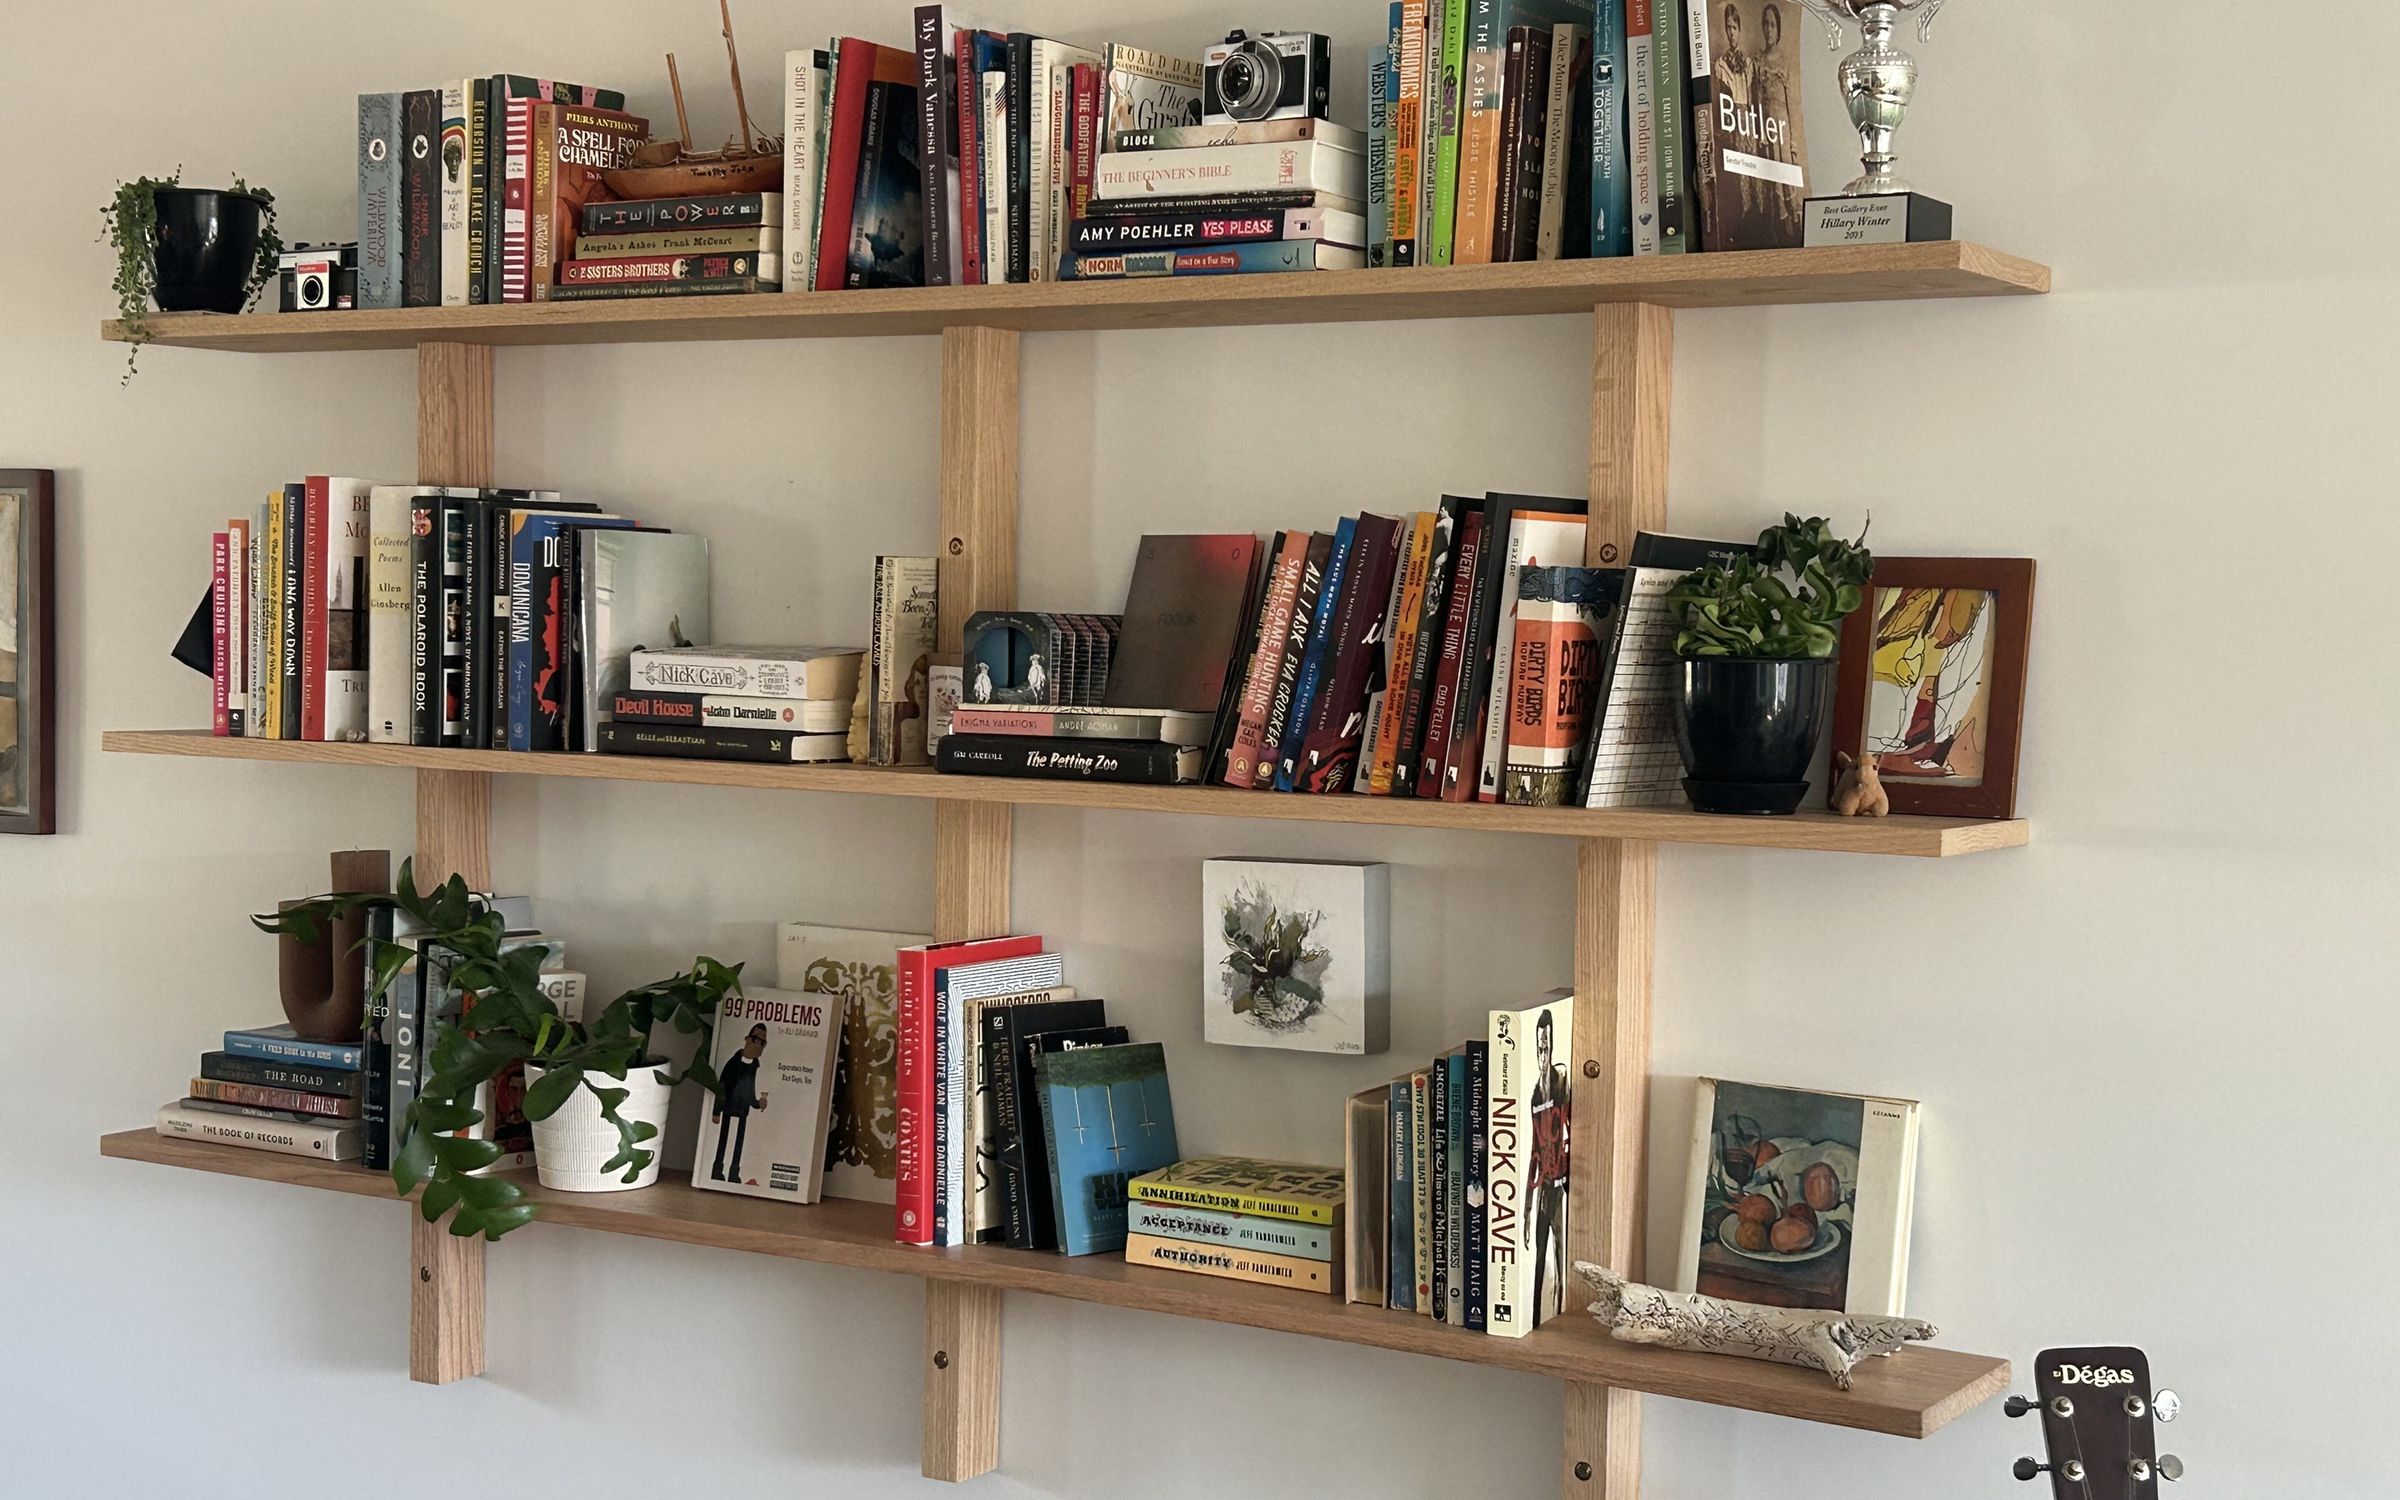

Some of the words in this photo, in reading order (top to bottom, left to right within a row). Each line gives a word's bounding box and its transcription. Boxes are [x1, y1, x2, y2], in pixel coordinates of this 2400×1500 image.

[919, 18, 935, 43] My
[1476, 23, 1488, 54] THE
[1693, 10, 1702, 40] Judith
[1116, 45, 1166, 68] ROALD
[1399, 2, 1423, 100] FREAKONOMICS
[1556, 33, 1568, 61] Alice
[1637, 44, 1649, 67] the
[1695, 42, 1704, 70] Butler
[794, 66, 806, 92] SHOT
[922, 47, 937, 88] Dark
[1637, 69, 1649, 89] art
[1660, 41, 1670, 86] ELEVEN
[794, 97, 805, 108] IN
[1078, 91, 1091, 113] THE
[1158, 85, 1186, 111] The
[1371, 61, 1387, 128] WEBSTER'S
[1472, 63, 1485, 118] ASHES
[1638, 92, 1650, 108] of
[566, 113, 595, 126] PIERS
[596, 117, 640, 133] ANTHONY
[794, 112, 806, 132] THE
[925, 91, 939, 155] Vanessa
[1441, 84, 1457, 137] SKIN
[1552, 105, 1563, 127] The
[1604, 88, 1612, 131] WALKING
[1662, 97, 1671, 124] EMILY
[1718, 93, 1787, 146] Butler
[558, 127, 569, 145] A
[571, 129, 615, 152] SPELL
[1122, 134, 1155, 147] BLOCK
[1593, 89, 1605, 163] TOGETHER
[1635, 110, 1651, 164] holding
[1697, 109, 1709, 144] Gender
[793, 137, 805, 170] HEART
[1077, 115, 1090, 177] GODFATHER
[1549, 128, 1560, 166] Moons
[1103, 172, 1125, 183] THE
[1128, 168, 1196, 182] BEGINNER'S
[1199, 165, 1232, 178] BIBLE
[1370, 136, 1386, 204] THESAURUS
[1549, 167, 1558, 179] of
[1635, 166, 1650, 204] space
[1665, 172, 1675, 209] MANDEL
[411, 173, 421, 260] WILDWOOD
[421, 193, 430, 236] UNDER
[660, 203, 735, 222] POWER
[1820, 217, 1855, 231] Hillary
[1857, 216, 1891, 227] Winter
[1823, 206, 1839, 214] Best
[1840, 204, 1868, 215] Gallery
[1869, 203, 1888, 213] Ever
[367, 192, 377, 265] IMPERIUM
[377, 186, 387, 268] WILDWOOD
[1080, 227, 1114, 242] AMY
[1120, 224, 1195, 240] POEHLER
[1202, 220, 1225, 236] YES
[1230, 218, 1274, 234] PLEASE
[470, 230, 483, 274] CROUCH
[583, 243, 624, 253] Angela's
[664, 239, 690, 248] Frank
[693, 238, 733, 247] McCourt
[586, 264, 624, 279] SISTERS
[624, 262, 670, 277] BROTHERS
[1087, 256, 1123, 273] NORM
[215, 543, 226, 572] PARK
[373, 535, 410, 548] Collected
[1508, 537, 1518, 577] maxine
[377, 553, 403, 564] Poems
[1457, 544, 1474, 578] EVERY
[377, 583, 402, 593] Allen
[416, 561, 427, 589] THE
[1279, 558, 1300, 603] SMALL
[1303, 560, 1321, 594] ALL
[215, 577, 226, 634] CRUISING
[370, 599, 411, 611] Ginsberg
[511, 562, 531, 643] DOMINICANA
[1300, 597, 1312, 610] I
[1449, 584, 1469, 627] LITTLE
[416, 594, 427, 667] POLAROID
[1269, 608, 1289, 649] GAME
[1290, 607, 1311, 649] ASK
[286, 638, 297, 676] DOWN
[1443, 629, 1462, 660] THING
[659, 666, 696, 685] Nick
[699, 668, 734, 686] Cave
[1282, 652, 1298, 681] EVA
[1526, 641, 1545, 685] DIRTY
[415, 671, 426, 712] BOOK
[1252, 652, 1278, 715] HUNTING
[615, 697, 649, 716] Devil
[652, 699, 694, 718] House
[733, 706, 777, 720] Darnielle
[1265, 682, 1291, 748] CROCKER
[1524, 687, 1544, 727] BIRDS
[665, 734, 706, 745] SEBASTIAN
[991, 719, 1038, 730] VARIATIONS
[1026, 750, 1048, 768] The
[1049, 751, 1092, 775] Petting
[1095, 754, 1118, 771] Zoo
[904, 970, 913, 1020] EIGHT
[936, 991, 946, 1023] WOLF
[724, 996, 744, 1018] 99
[746, 1000, 823, 1028] PROBLEMS
[936, 1025, 946, 1038] IN
[397, 1009, 413, 1087] JONI
[903, 1027, 913, 1077] YEARS
[936, 1041, 946, 1079] WHITE
[1000, 1035, 1010, 1066] TERRY
[1472, 1050, 1482, 1072] The
[264, 1070, 287, 1082] THE
[292, 1073, 323, 1086] ROAD
[936, 1082, 946, 1105] VAN
[995, 1082, 1006, 1126] GAIMAN
[1003, 1071, 1015, 1131] PRATCHETT
[1470, 1076, 1483, 1128] Midnight
[202, 1125, 217, 1135] THE
[219, 1127, 241, 1139] BOOK
[244, 1130, 255, 1140] OF
[257, 1132, 294, 1146] RECORDS
[936, 1112, 946, 1142] JOHN
[1435, 1128, 1446, 1149] Life
[1492, 1097, 1517, 1173] NICK
[900, 1107, 913, 1181] COATES
[1470, 1133, 1483, 1177] Library
[936, 1144, 946, 1206] DARNIELLE
[1008, 1172, 1017, 1202] GOOD
[1434, 1170, 1447, 1202] Times
[1450, 1171, 1461, 1206] BRAVING
[1140, 1186, 1240, 1209] ANNIHILATION
[1242, 1199, 1257, 1210] JEFF
[1258, 1201, 1300, 1216] VANDERMEER
[1435, 1203, 1447, 1216] of
[1142, 1214, 1232, 1238] ACCEPTANCE
[1239, 1229, 1253, 1239] JEFF
[1255, 1231, 1297, 1246] VANDERMEER
[1471, 1212, 1481, 1253] MATT
[1491, 1179, 1516, 1265] CAVE
[1432, 1219, 1447, 1263] Michael
[1449, 1217, 1461, 1269] WILDERNESS
[1153, 1246, 1232, 1270] AUTHORITY
[1236, 1261, 1250, 1271] JEFF
[1251, 1263, 1293, 1278] VANDERMEER
[1435, 1267, 1446, 1278] K
[1471, 1259, 1481, 1297] HAIG
[2059, 1364, 2135, 1388] Dégas
